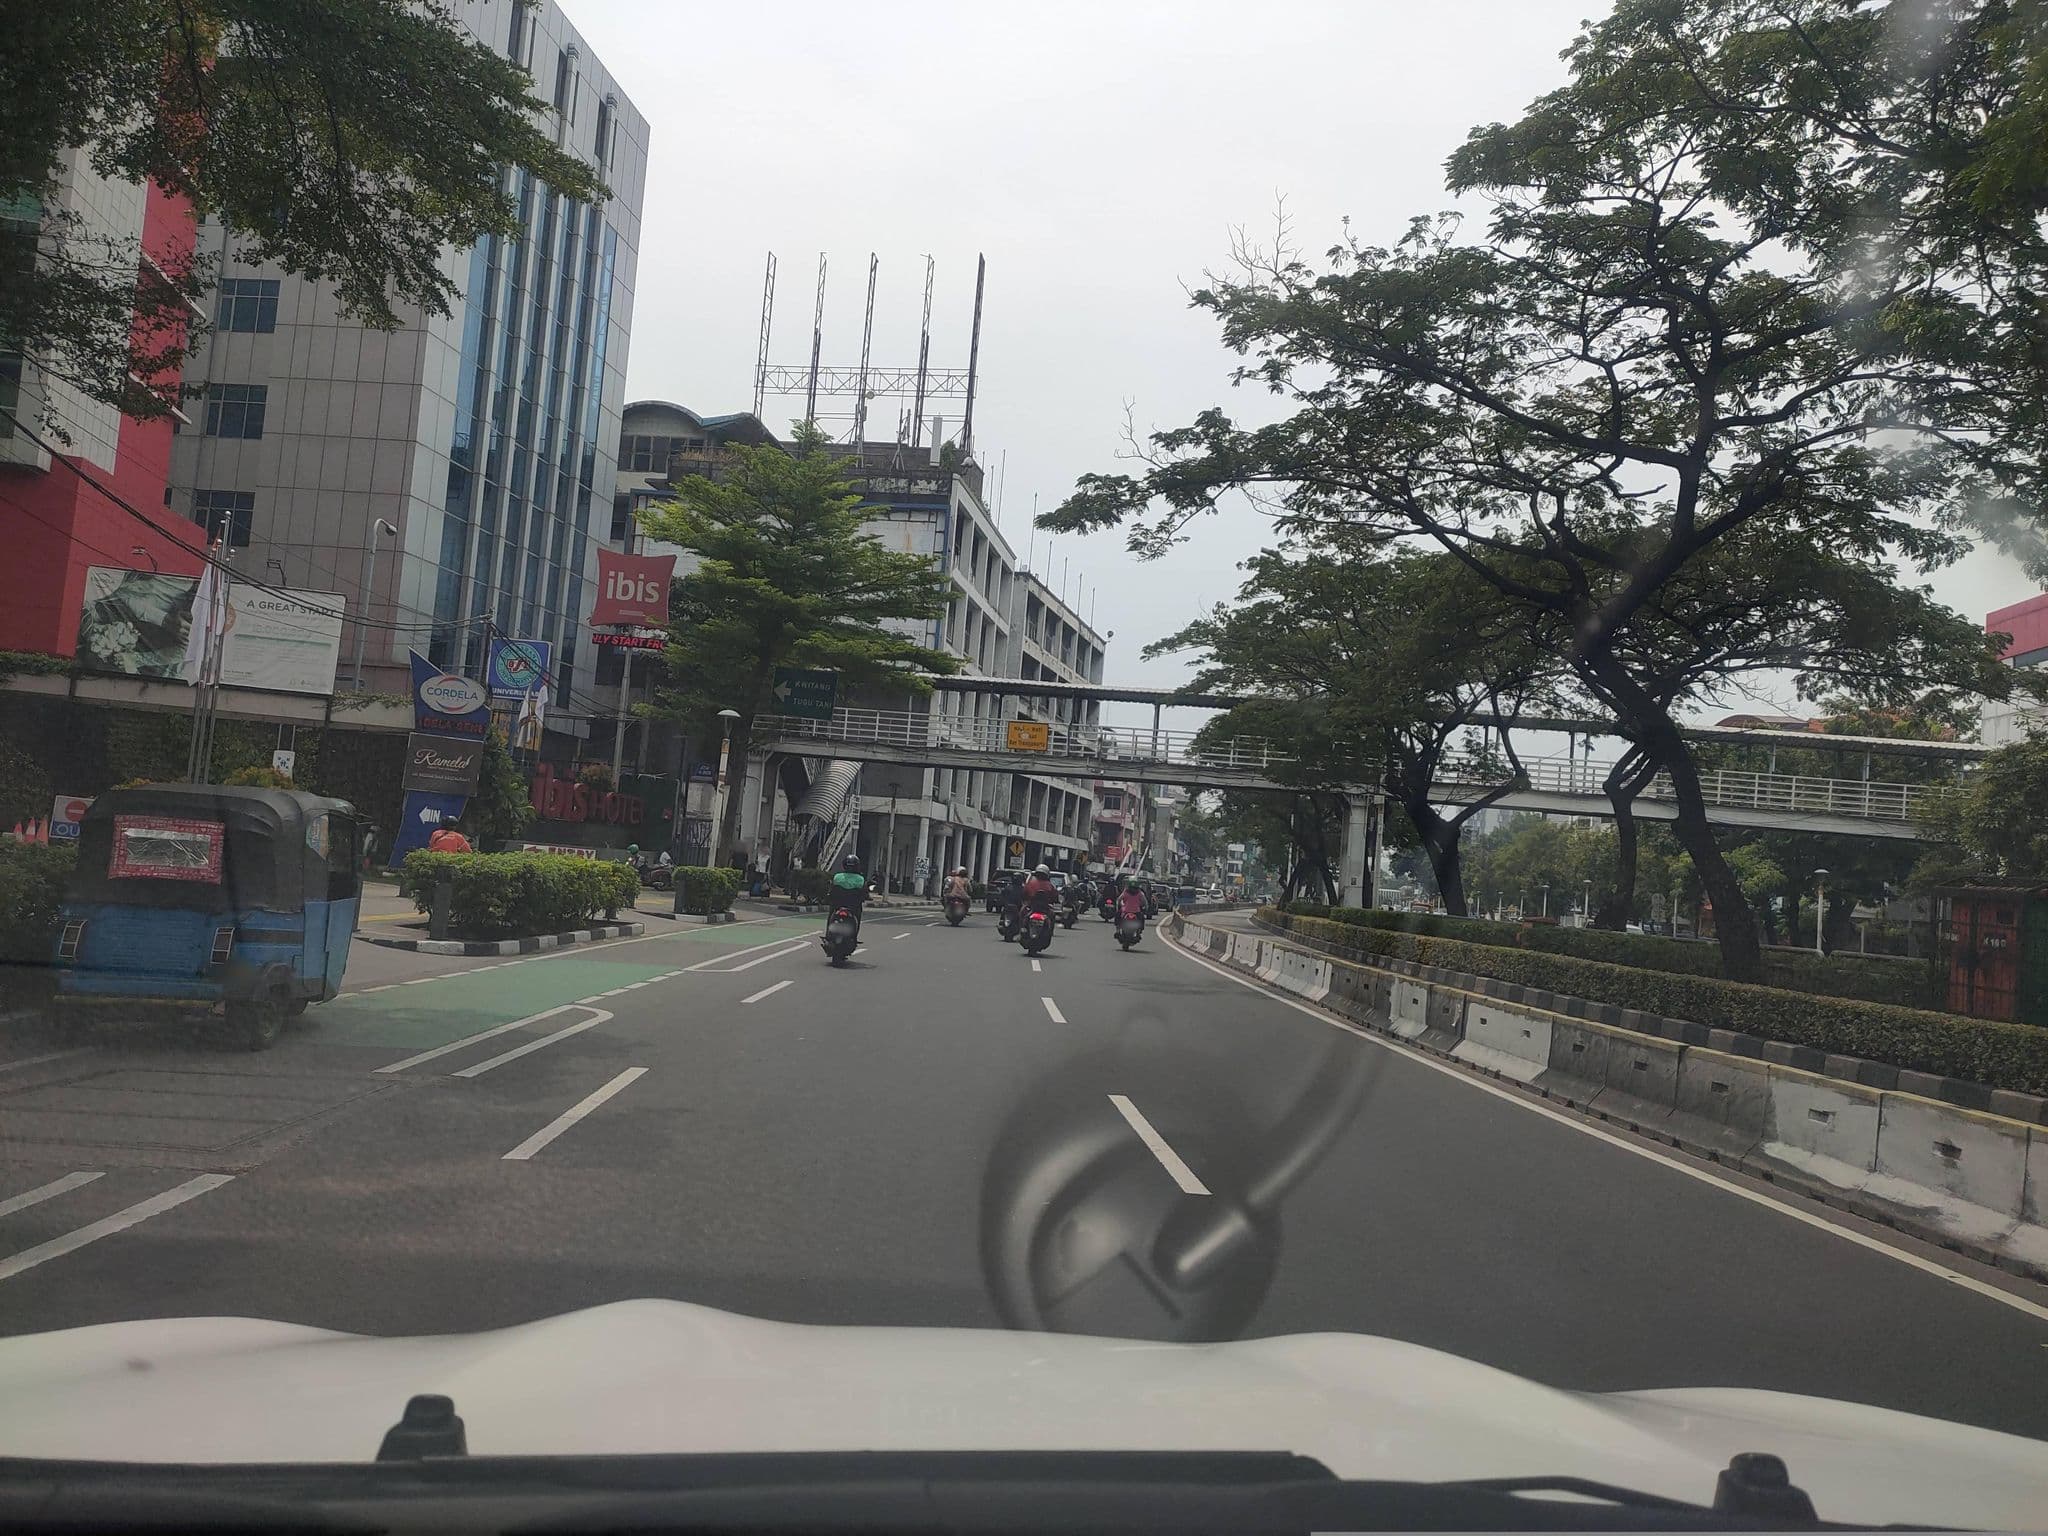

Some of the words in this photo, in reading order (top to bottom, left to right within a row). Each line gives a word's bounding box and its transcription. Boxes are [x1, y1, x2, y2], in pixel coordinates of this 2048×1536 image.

[607, 570, 660, 603] ibis
[246, 599, 255, 609] A
[258, 601, 297, 612] GREAT
[300, 606, 338, 617] START
[612, 636, 645, 646] START
[794, 680, 832, 691] KWITANG
[427, 686, 479, 701] CORDELA
[792, 697, 815, 706] TUGU
[532, 762, 589, 823] ibis
[430, 808, 441, 824] IN
[57, 823, 80, 837] OU
